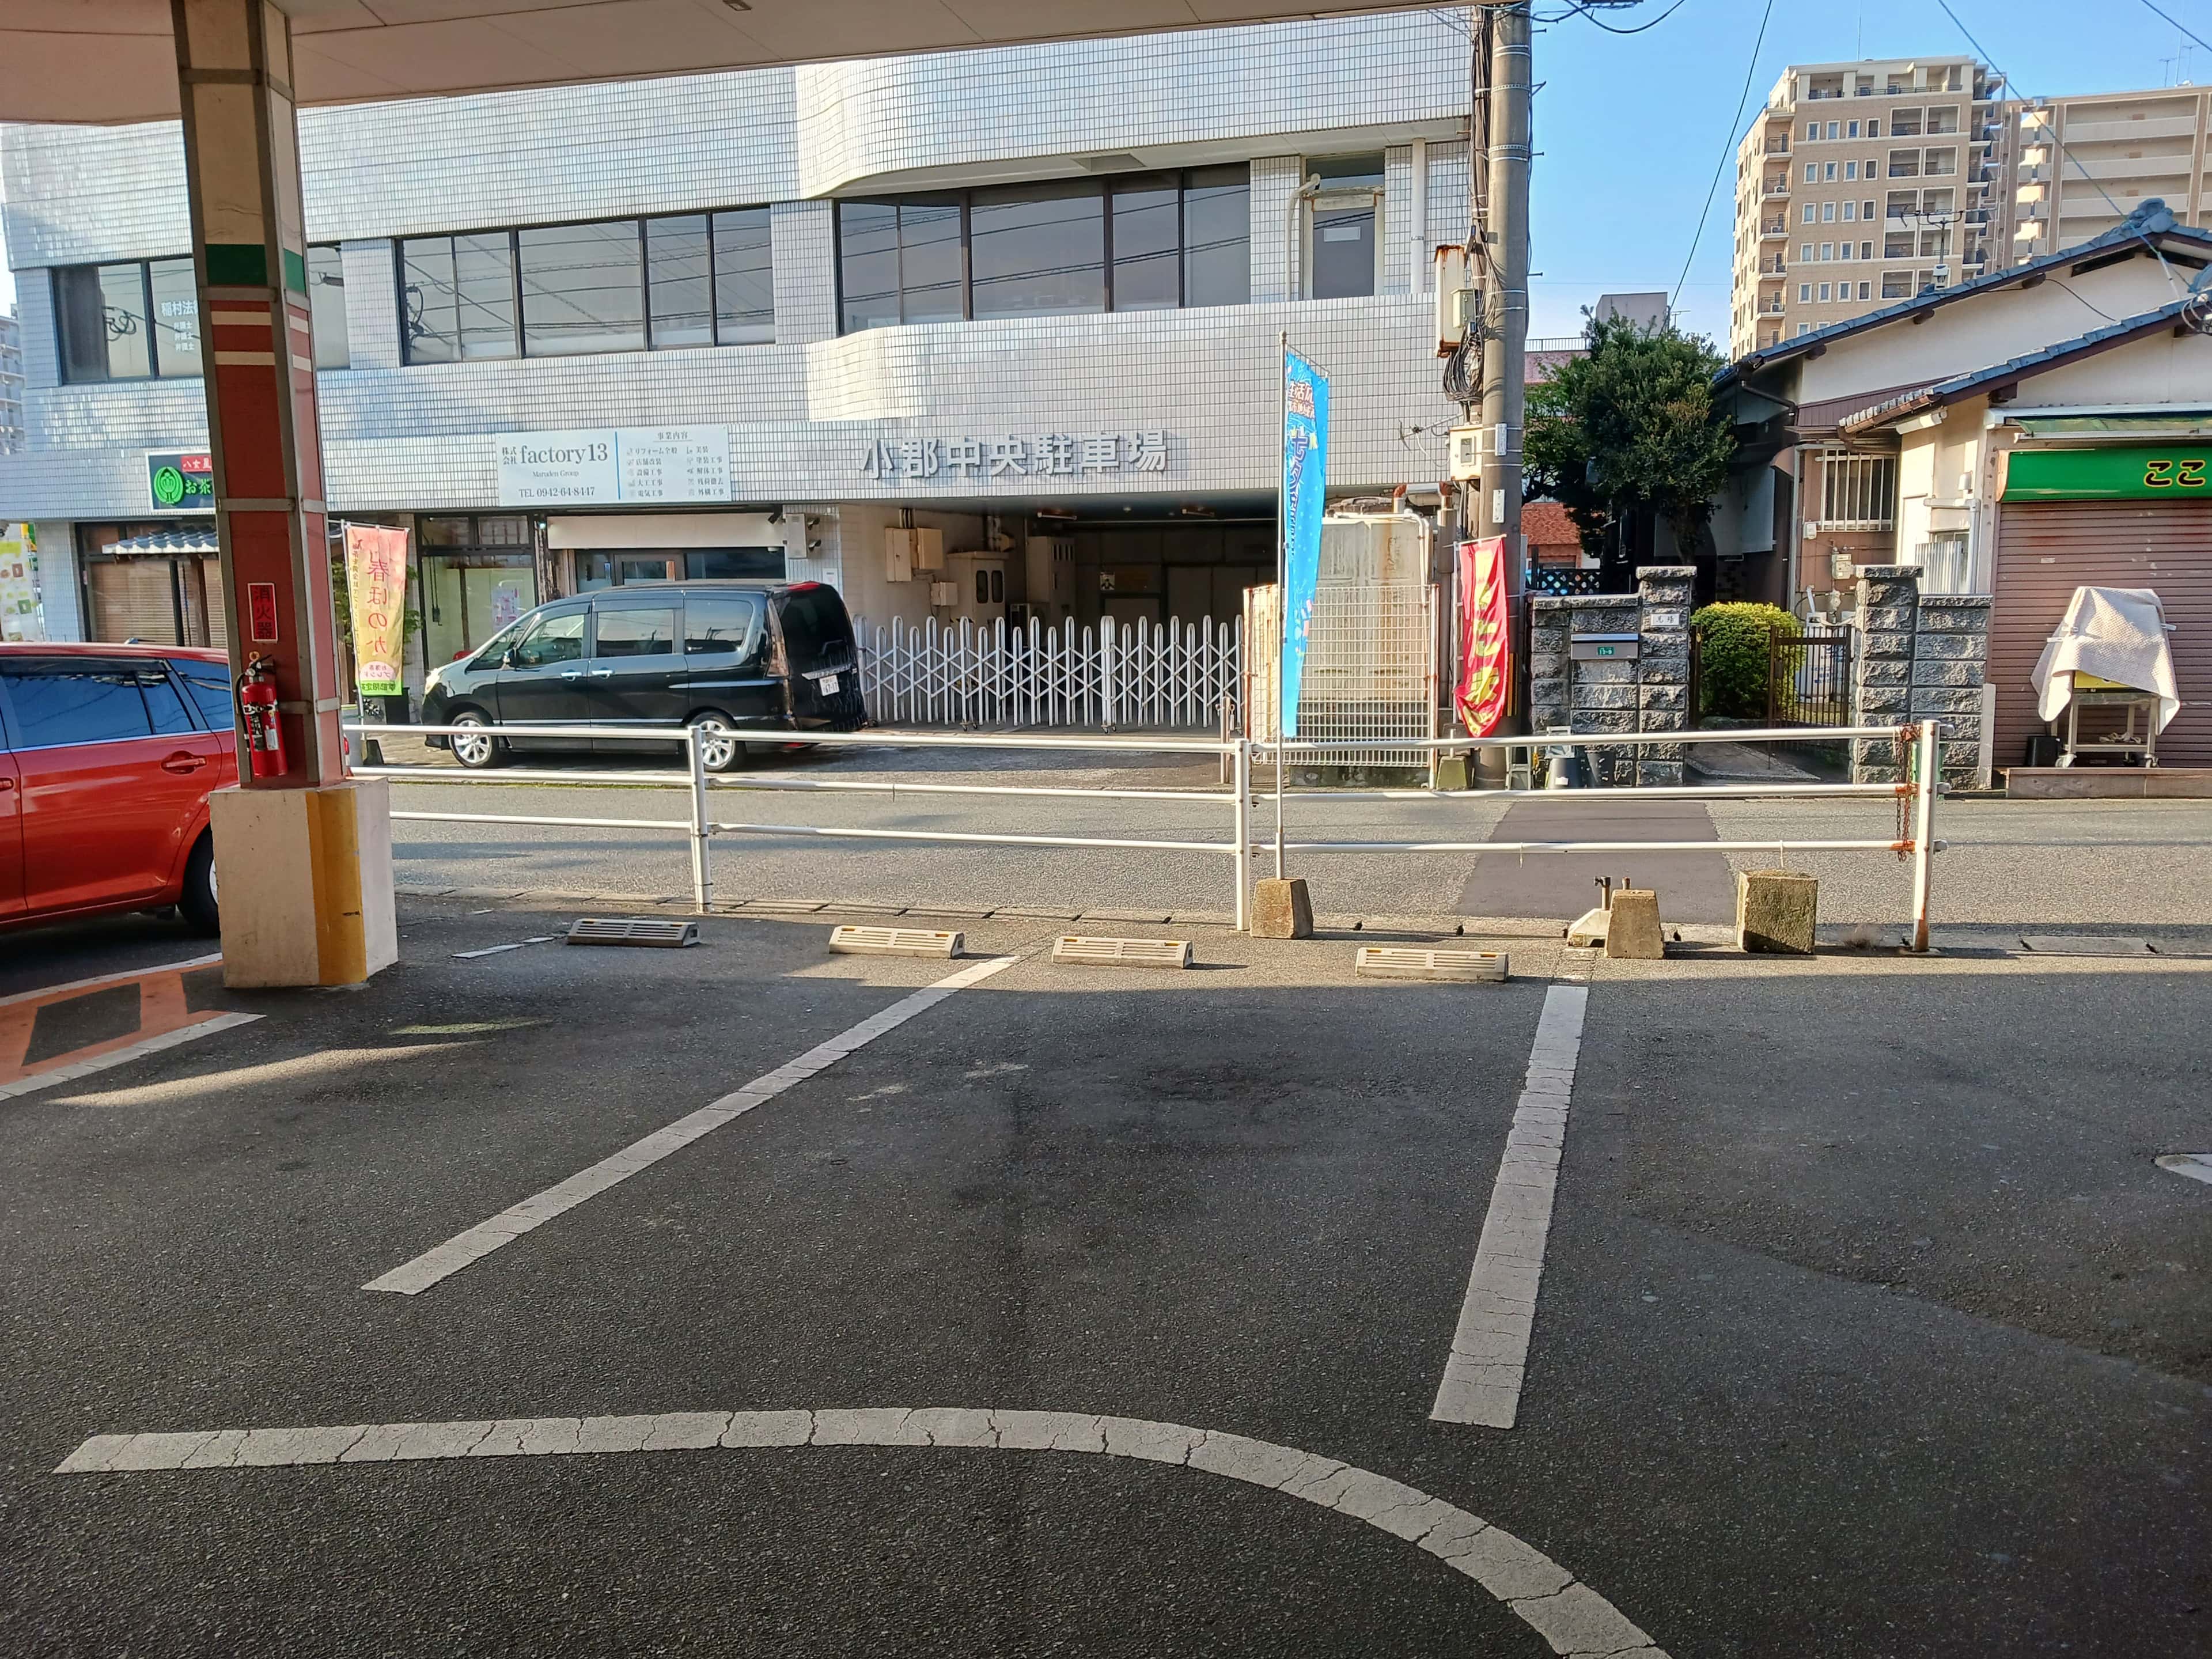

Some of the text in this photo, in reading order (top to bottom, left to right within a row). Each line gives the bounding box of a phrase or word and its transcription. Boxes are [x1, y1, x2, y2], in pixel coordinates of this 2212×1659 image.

[658, 431, 688, 440] 事業内容
[635, 446, 677, 454] リフォーム全般
[860, 429, 1167, 479] 小郡中央駐車場
[636, 458, 662, 466] 店舗改装
[2143, 460, 2206, 487] ここ
[185, 479, 211, 494] お茶
[520, 489, 535, 498] TEL
[254, 586, 274, 638] 消火器
